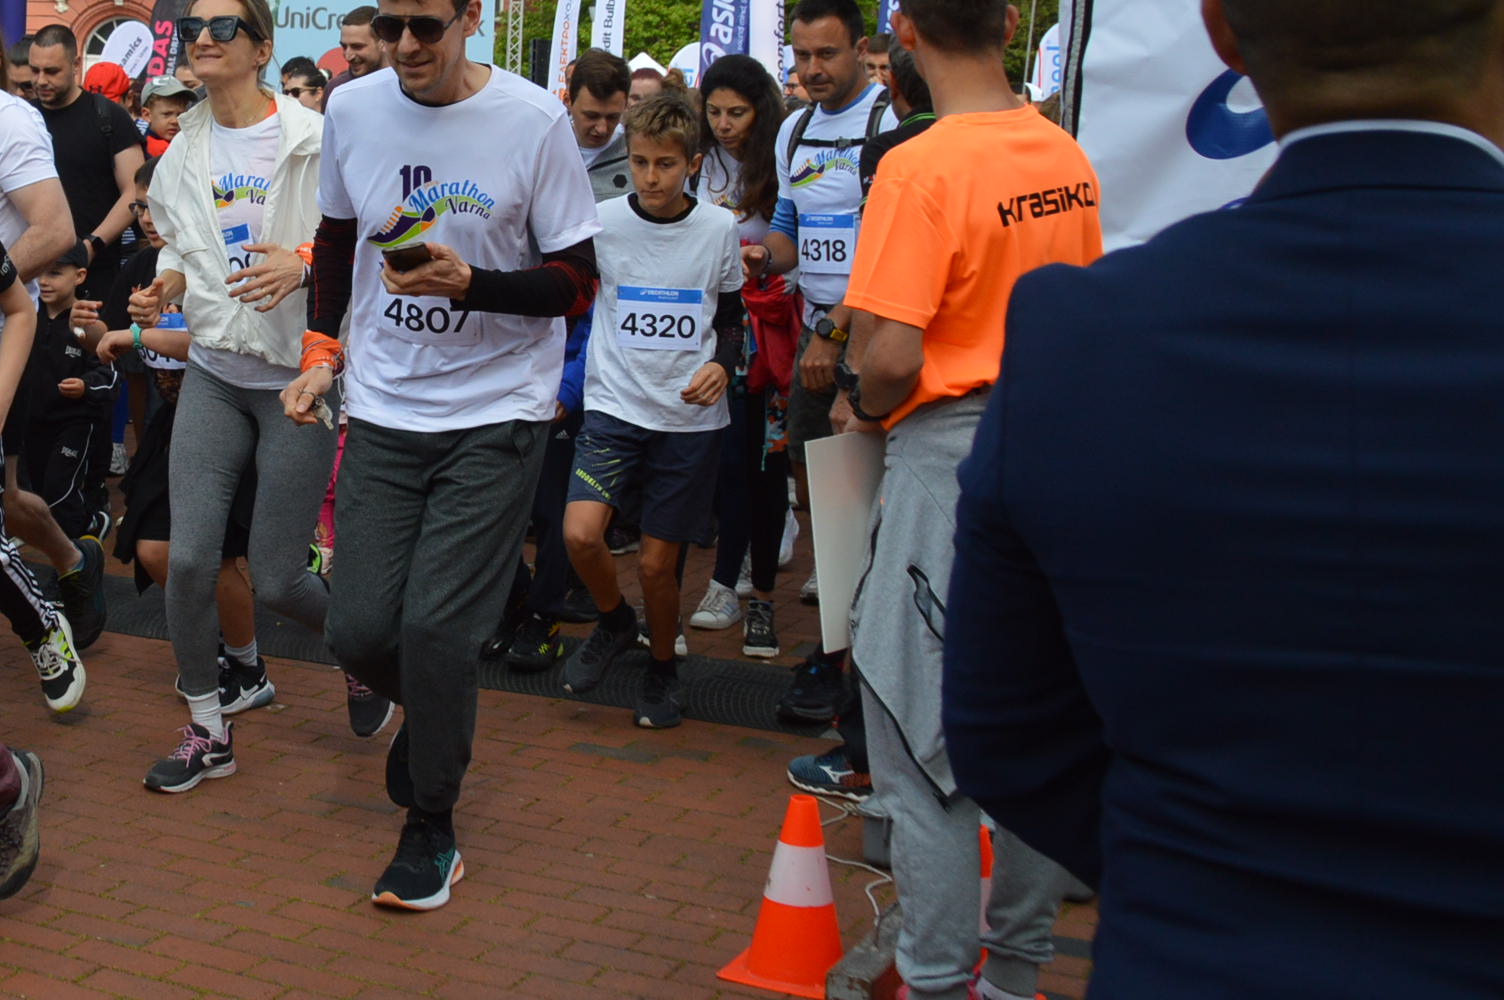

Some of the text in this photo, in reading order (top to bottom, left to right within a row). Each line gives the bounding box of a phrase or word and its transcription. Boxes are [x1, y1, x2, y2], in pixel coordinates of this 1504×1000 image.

[276, 6, 348, 31] UniCre
[602, 32, 613, 53] dit
[775, 1, 785, 86] comfort
[409, 179, 496, 215] Marathon
[445, 196, 491, 220] Varna
[801, 238, 847, 263] 4318
[384, 297, 470, 334] 4807
[620, 312, 696, 339] 4320
